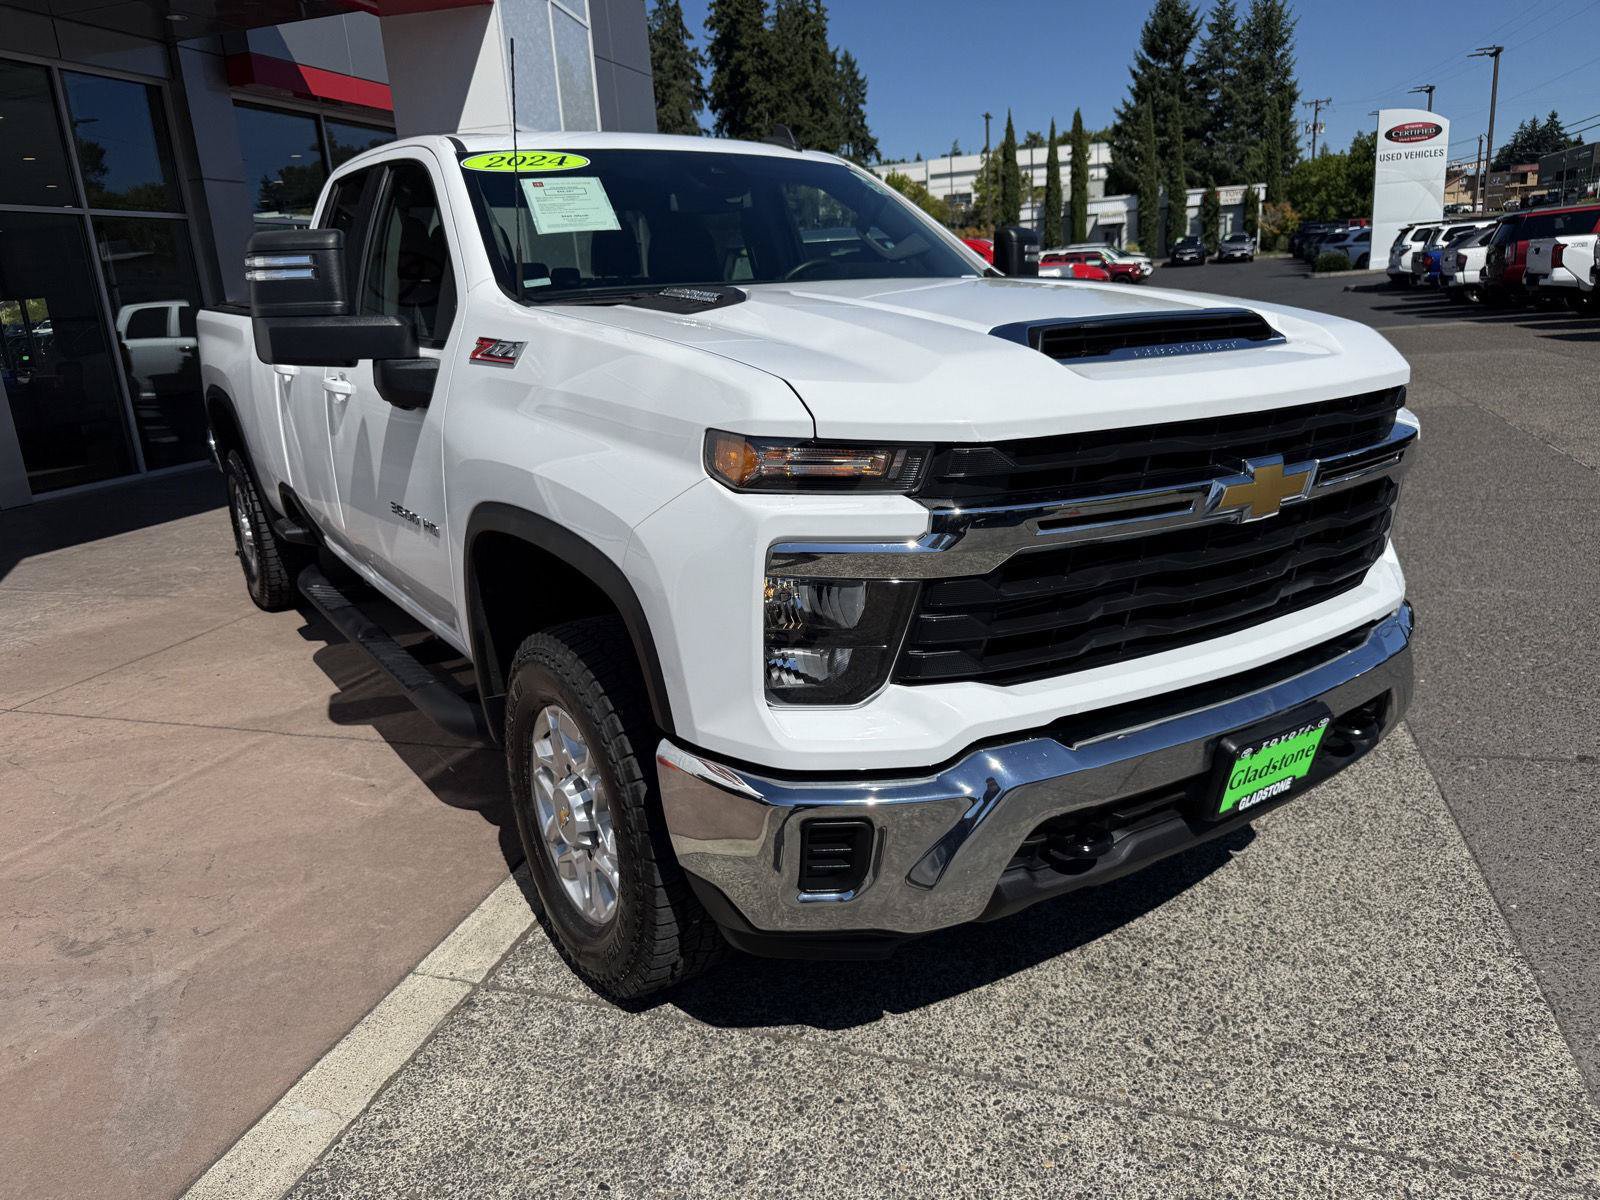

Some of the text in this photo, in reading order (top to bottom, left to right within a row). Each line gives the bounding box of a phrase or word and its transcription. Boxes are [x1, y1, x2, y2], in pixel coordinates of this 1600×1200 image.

[485, 155, 568, 168] 2024
[1379, 149, 1444, 162] USED VEHICLES
[1262, 725, 1314, 749] TOYOTA
[1229, 744, 1316, 790] Gladstone
[1239, 777, 1294, 811] GLADSTONE
